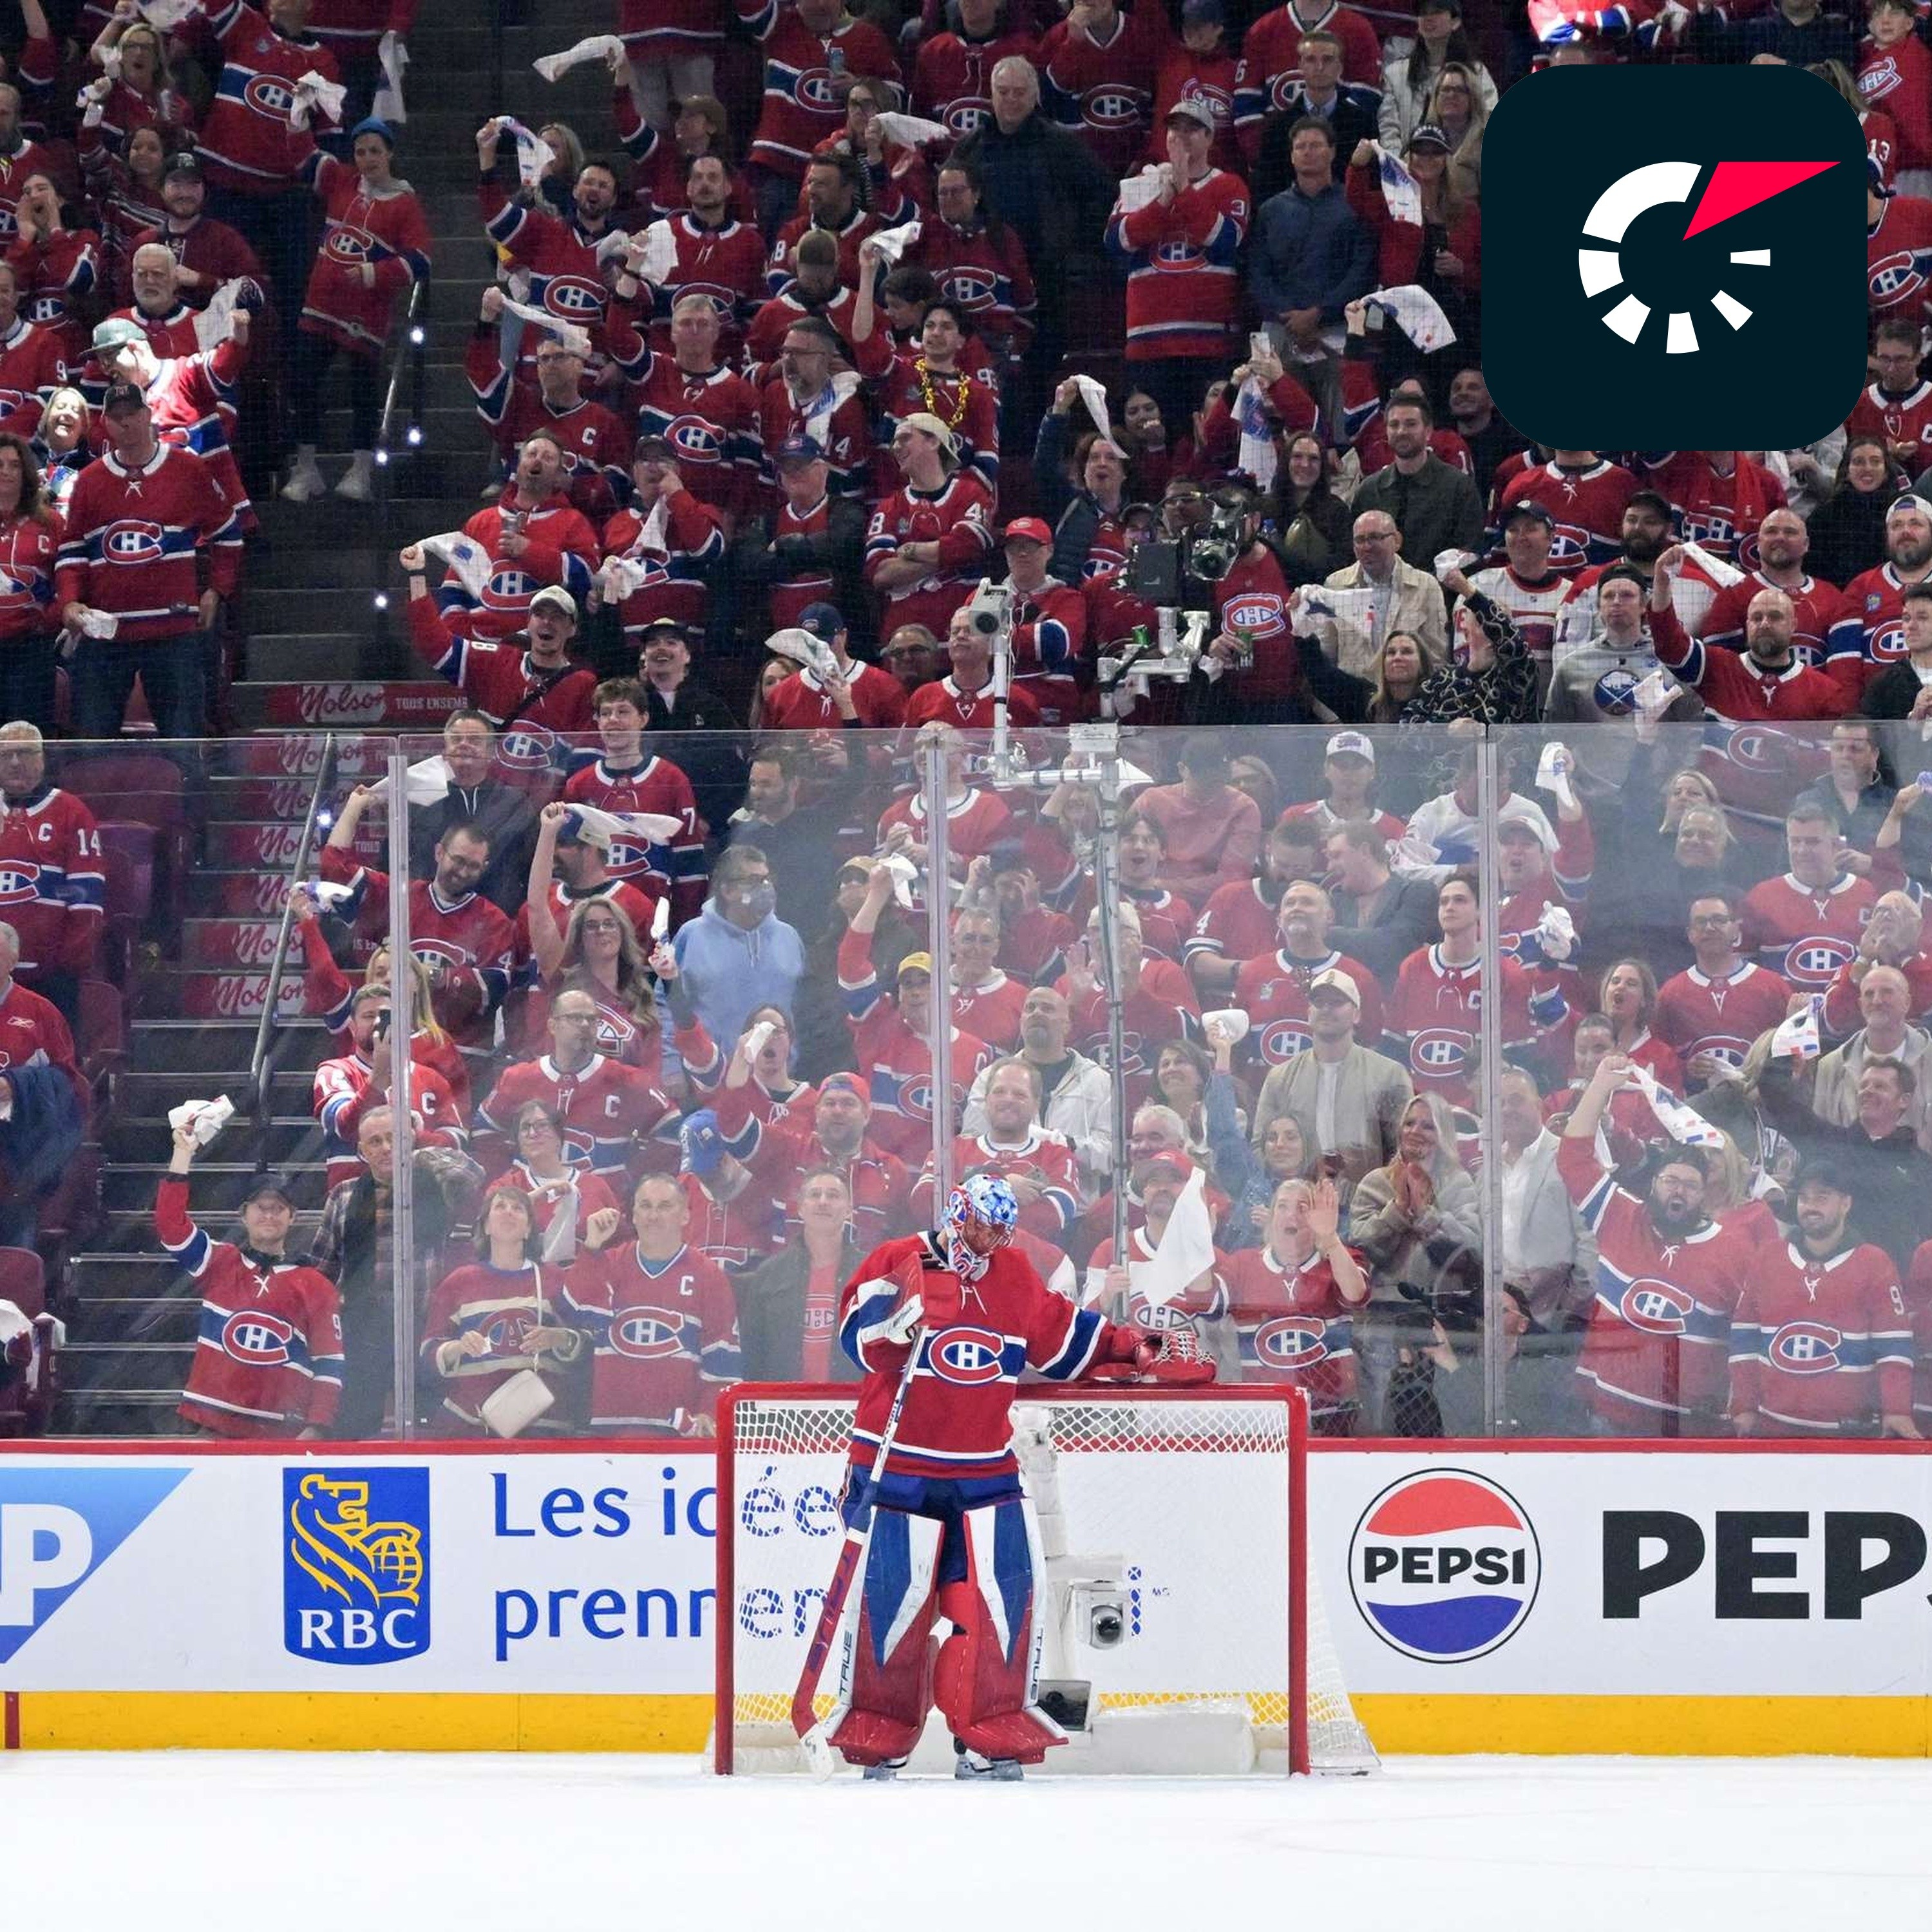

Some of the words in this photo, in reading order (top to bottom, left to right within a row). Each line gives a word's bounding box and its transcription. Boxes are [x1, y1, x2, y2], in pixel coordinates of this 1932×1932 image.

[582, 428, 596, 445] C
[38, 823, 53, 842] C
[77, 829, 102, 857] 14
[421, 1092, 436, 1115] C
[605, 1095, 620, 1118] C
[680, 1276, 694, 1296] C
[490, 1472, 630, 1538] Les
[0, 1503, 93, 1626] P
[1364, 1546, 1526, 1585] PEPSI
[1602, 1510, 1932, 1620] PEP
[298, 1609, 417, 1649] RBC
